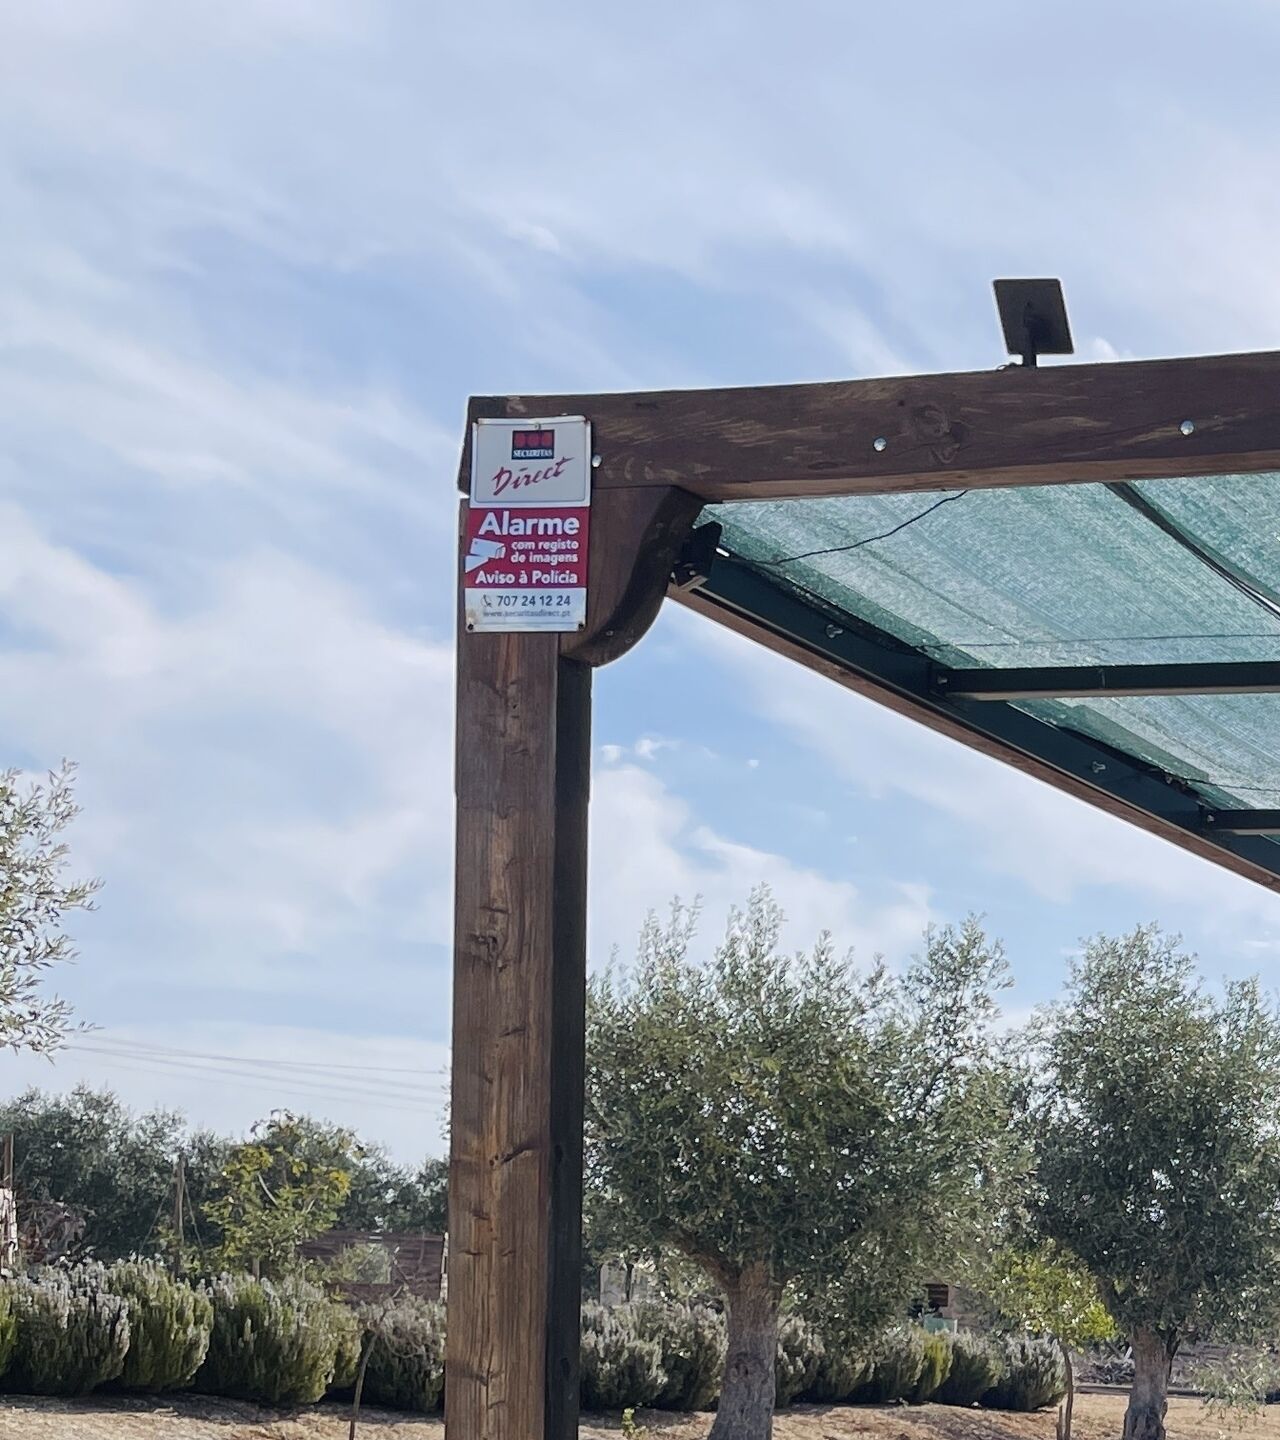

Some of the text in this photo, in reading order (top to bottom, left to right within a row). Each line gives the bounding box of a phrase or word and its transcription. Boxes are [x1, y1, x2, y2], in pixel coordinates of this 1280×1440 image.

[513, 449, 552, 458] SECURITAS
[492, 456, 575, 496] Direct
[478, 511, 580, 536] Alarme
[511, 539, 579, 553] com registo
[511, 553, 578, 566] de imagens
[475, 569, 578, 584] Aviso à Polícia
[497, 595, 571, 606] 707 24 12 24
